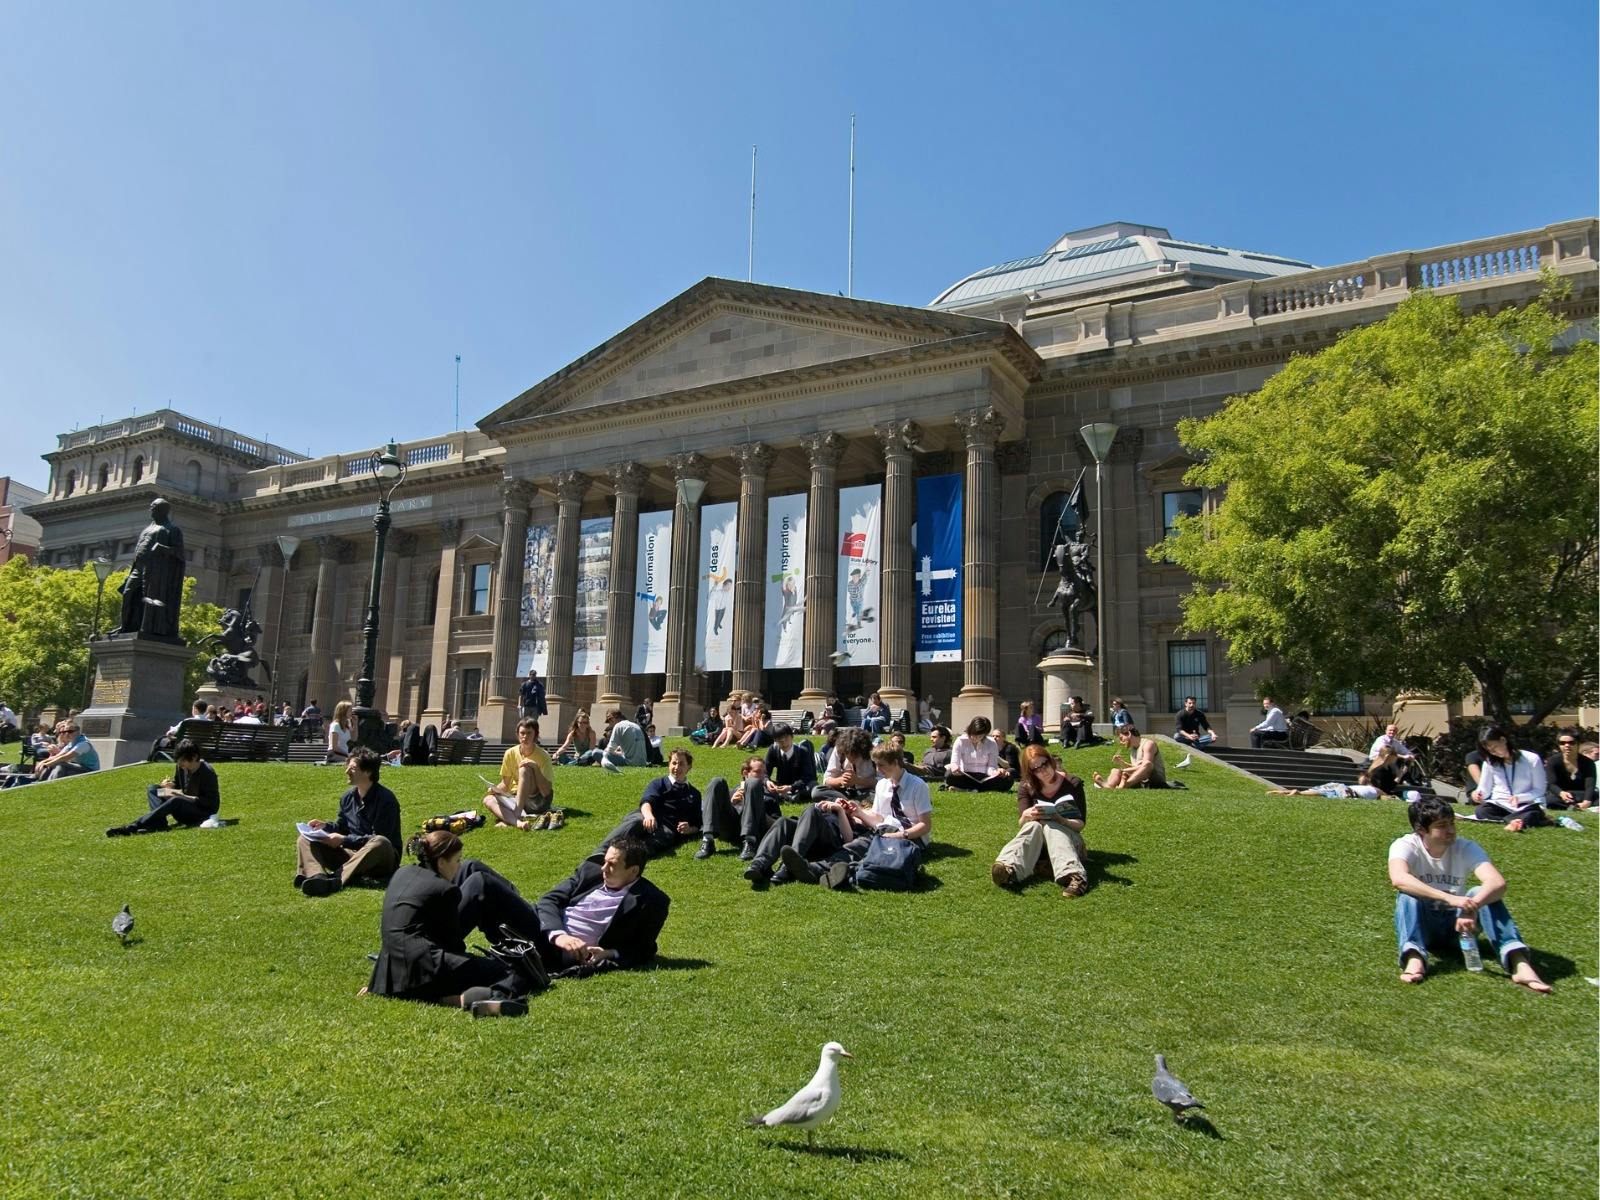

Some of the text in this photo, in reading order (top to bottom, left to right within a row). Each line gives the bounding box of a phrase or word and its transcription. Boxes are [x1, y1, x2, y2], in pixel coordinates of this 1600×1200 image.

[288, 511, 336, 528] STATE
[921, 603, 956, 614] Eureka
[921, 613, 956, 624] revisited
